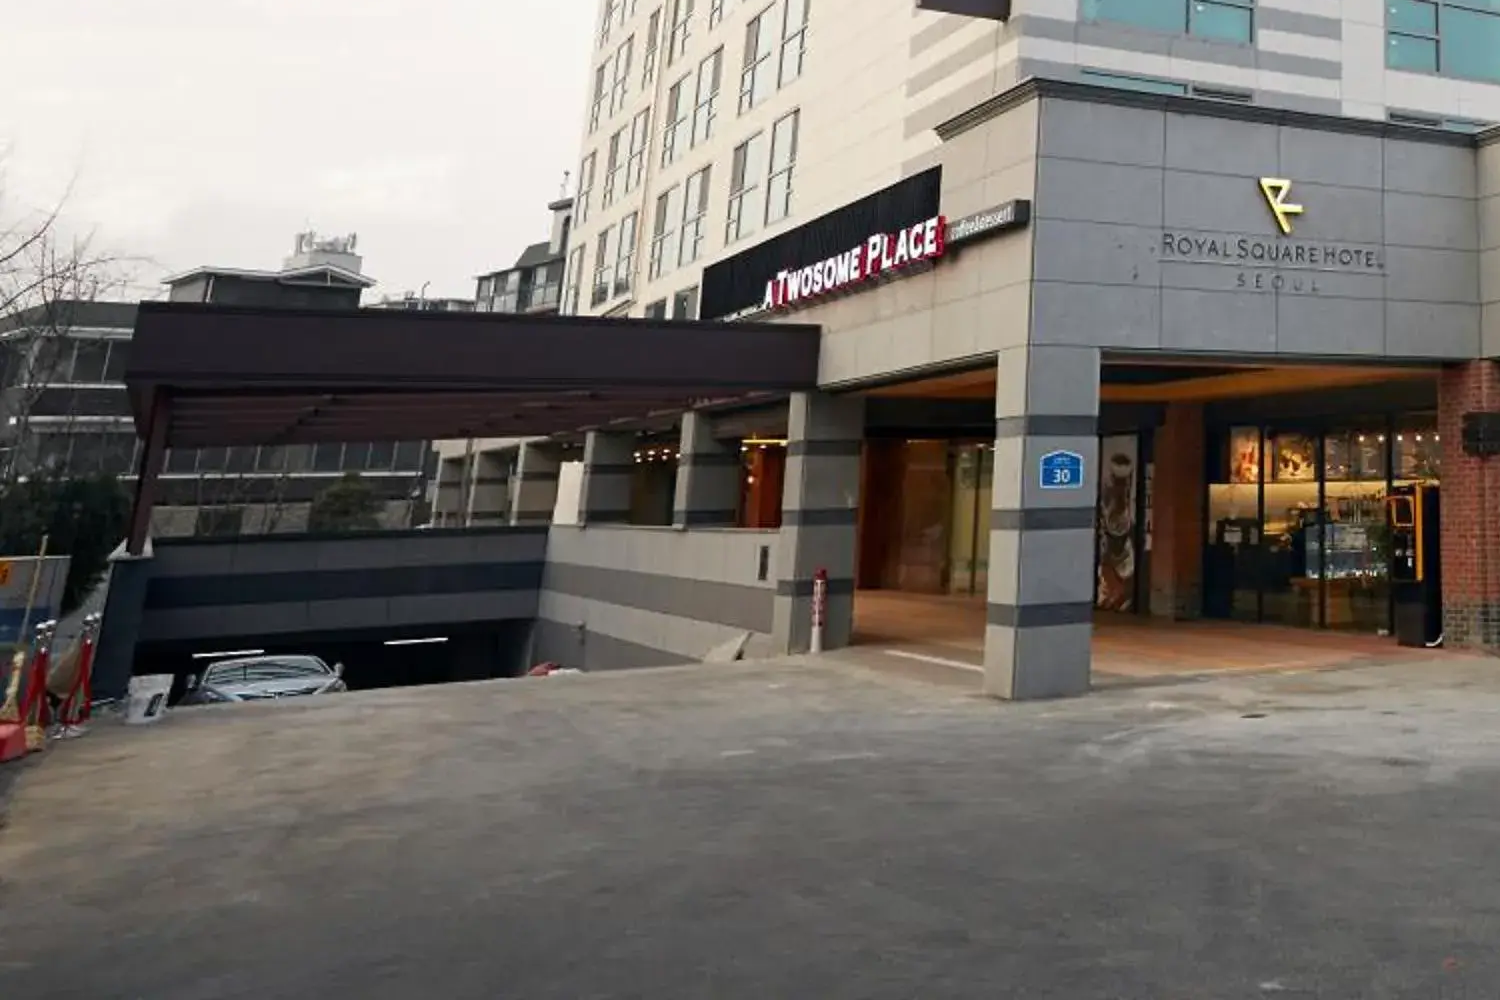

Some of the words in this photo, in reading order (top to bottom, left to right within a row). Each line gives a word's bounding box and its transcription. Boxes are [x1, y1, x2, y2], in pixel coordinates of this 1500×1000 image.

[1162, 232, 1232, 257] ROYAL
[1236, 239, 1319, 263] SQUARE
[763, 279, 773, 309] A
[776, 247, 861, 305] TWOSOME
[865, 216, 939, 275] PLACE
[1237, 272, 1319, 292] SEOUL
[1052, 469, 1070, 483] 30
